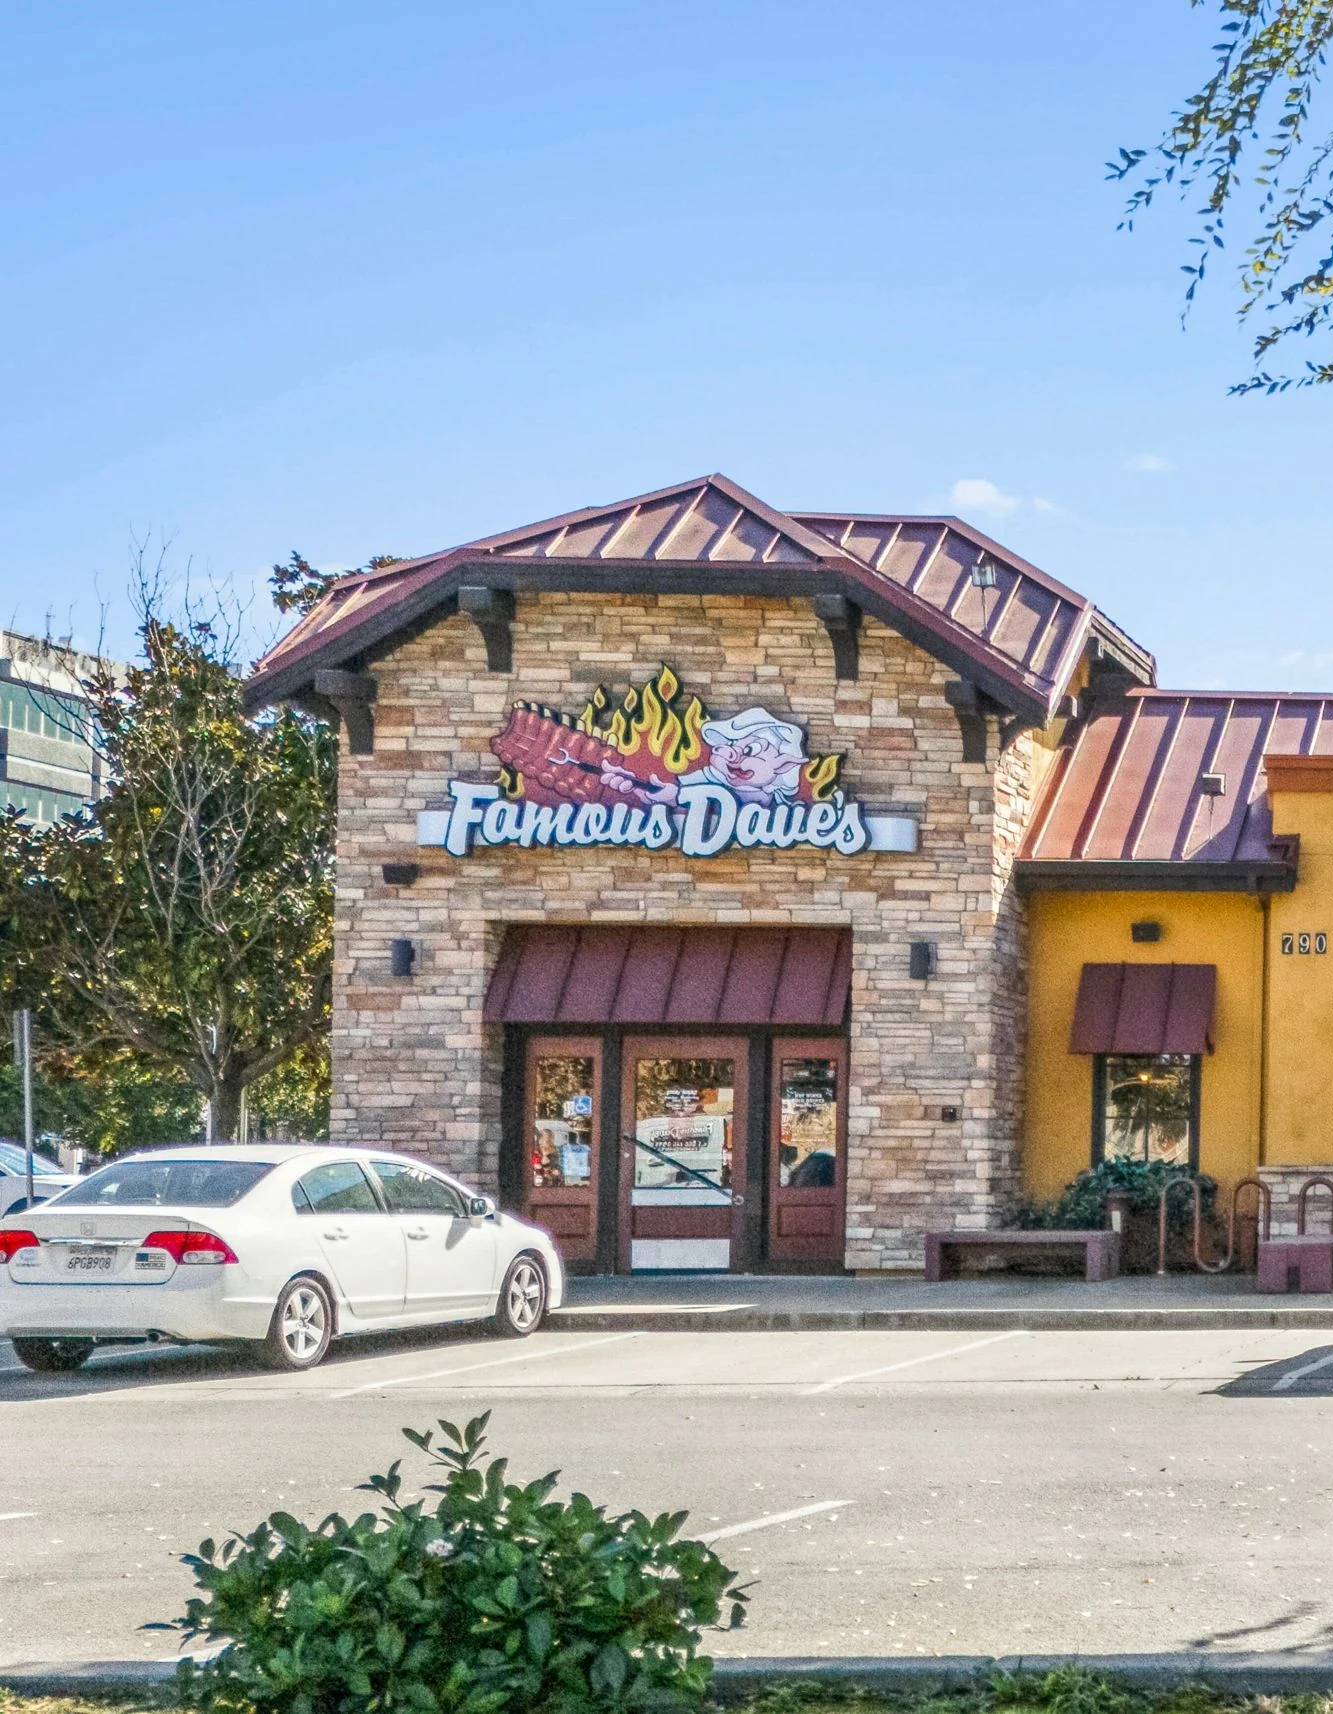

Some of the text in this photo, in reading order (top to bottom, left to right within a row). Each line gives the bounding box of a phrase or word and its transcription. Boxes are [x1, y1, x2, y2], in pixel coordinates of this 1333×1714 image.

[446, 780, 870, 857] Famous Dave's
[1282, 934, 1326, 954] 790
